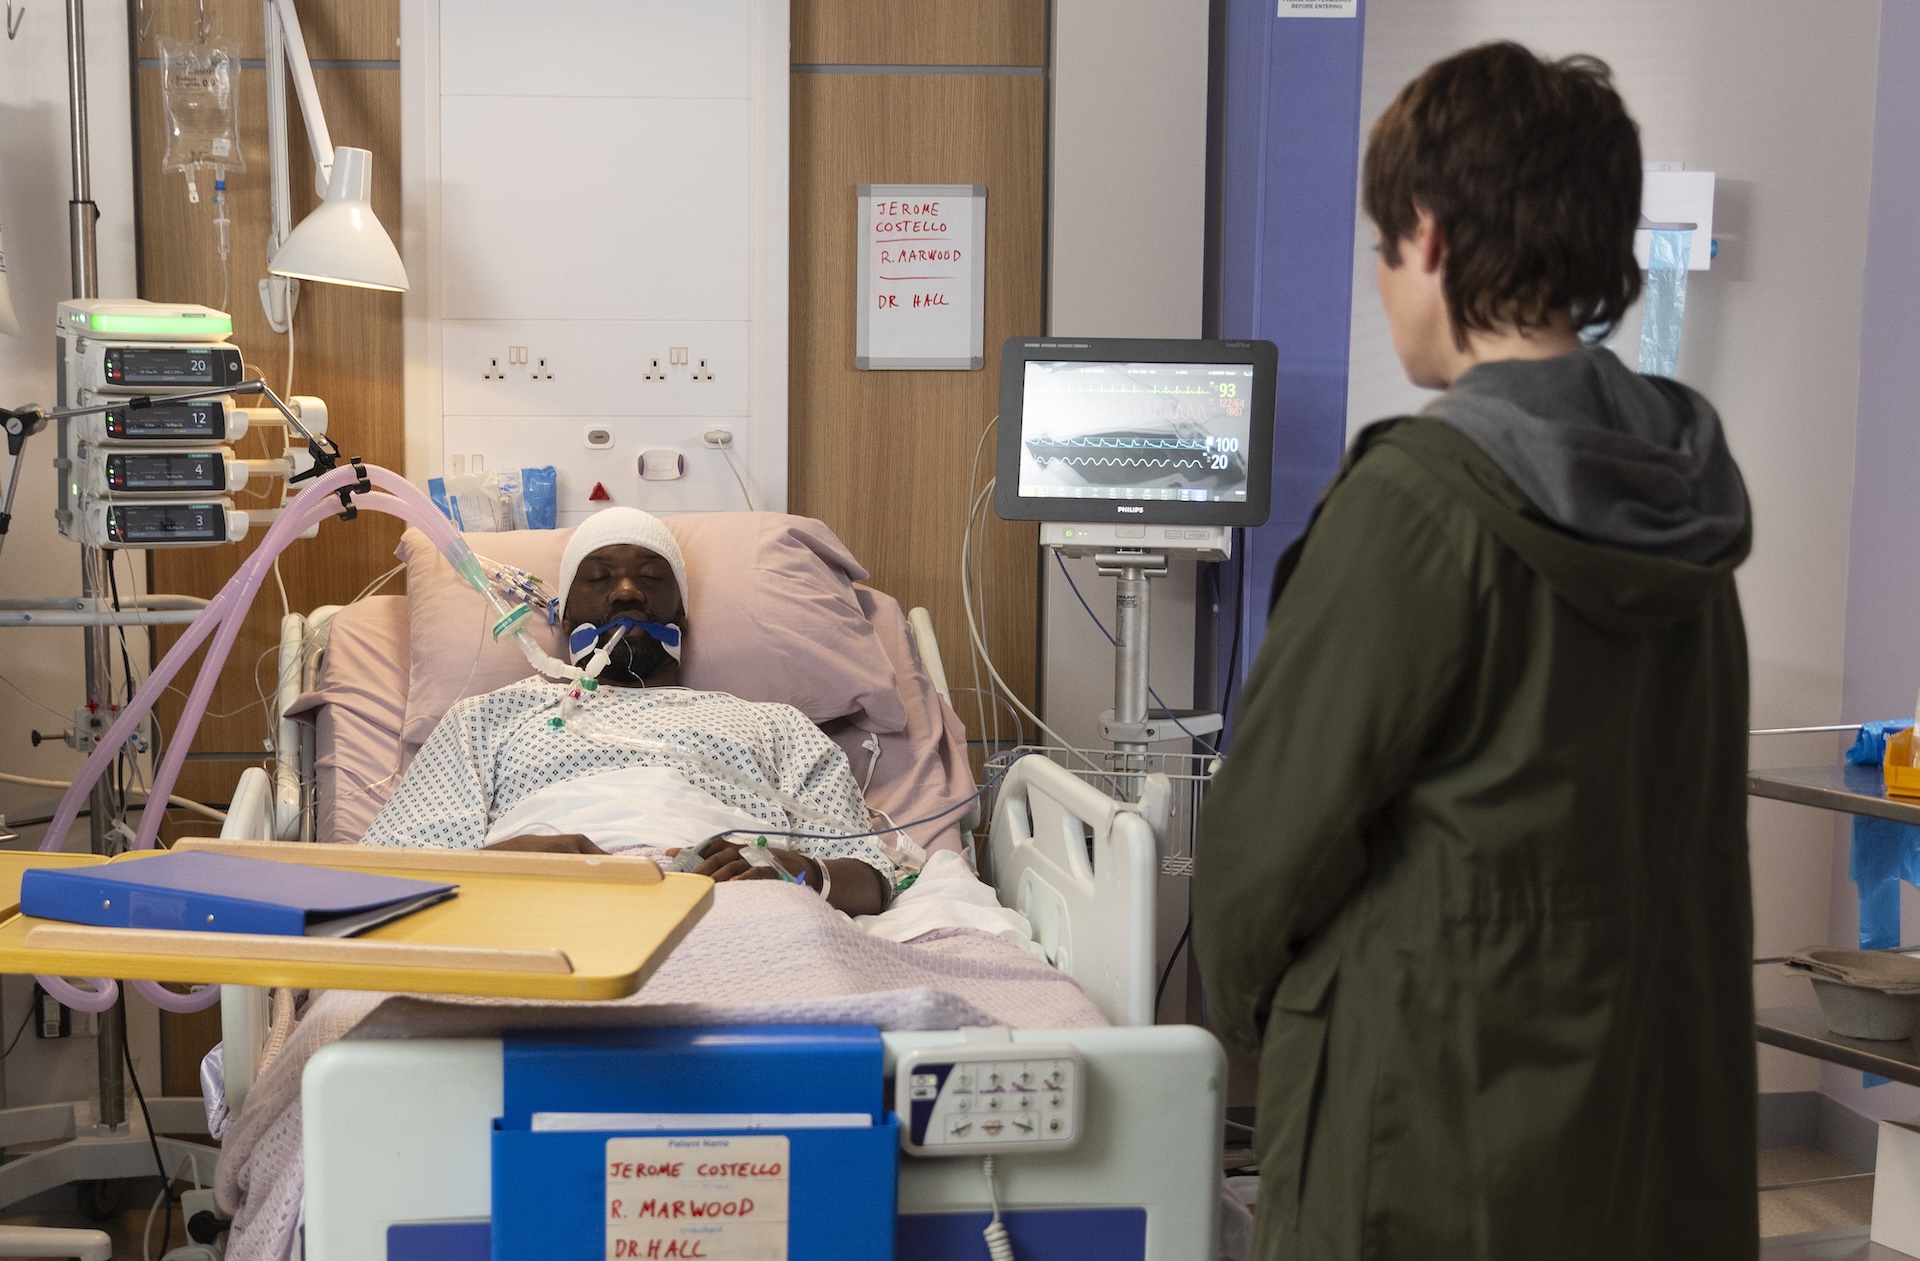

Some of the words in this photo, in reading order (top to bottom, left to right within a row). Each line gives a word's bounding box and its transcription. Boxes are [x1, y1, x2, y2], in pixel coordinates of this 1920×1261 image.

[877, 201, 940, 216] JEROME
[876, 220, 947, 232] COSTELLO
[878, 295, 899, 309] DR
[913, 293, 949, 308] HALL
[190, 359, 206, 372] 20
[1218, 382, 1237, 398] 93
[1219, 399, 1245, 408] 122/64
[192, 412, 207, 424] 12
[1215, 436, 1239, 453] 100
[1210, 454, 1229, 470] 20
[195, 464, 204, 475] 4
[196, 515, 204, 526] 3
[668, 1139, 700, 1148] Patient
[703, 1139, 729, 1148] Name
[610, 1162, 684, 1178] JEROME
[697, 1162, 781, 1177] COSTELLO
[612, 1199, 627, 1218] R.
[639, 1197, 754, 1218] MARWOOD
